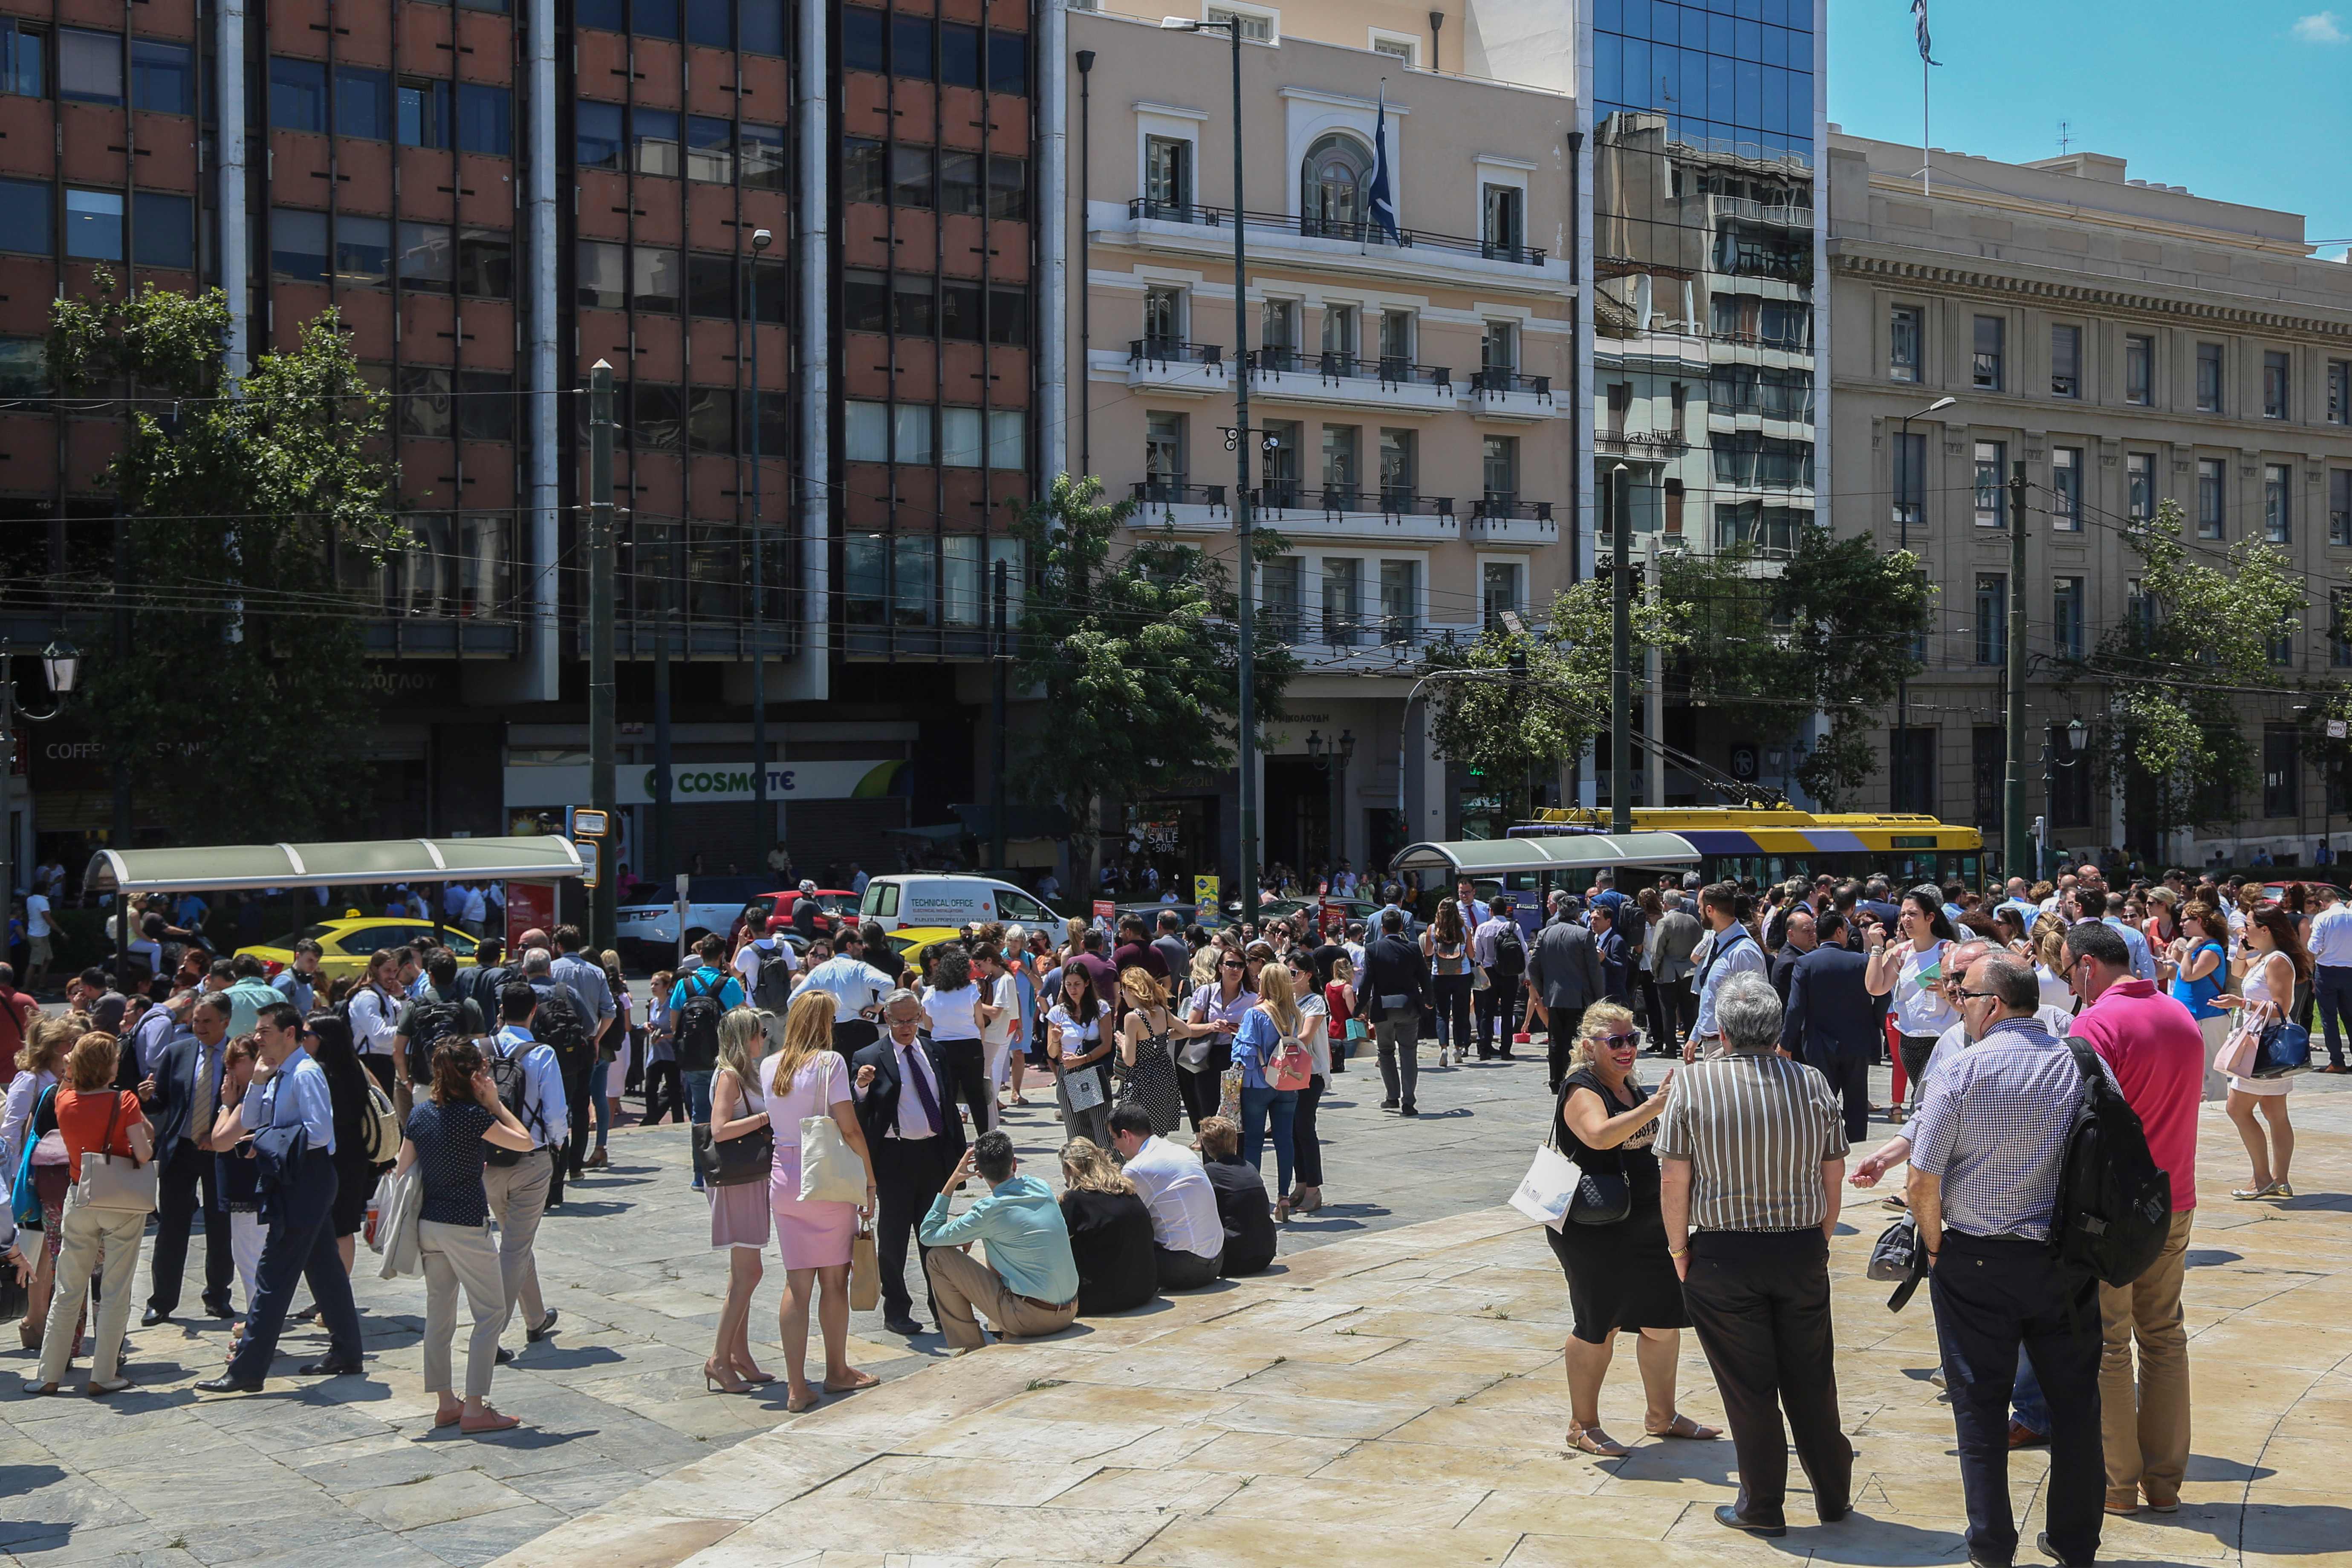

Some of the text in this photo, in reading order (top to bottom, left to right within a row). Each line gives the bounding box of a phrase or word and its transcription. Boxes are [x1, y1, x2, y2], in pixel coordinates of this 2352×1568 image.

[1148, 832, 1179, 843] SALE
[1153, 843, 1175, 852] -50%
[911, 899, 949, 907] TECHNICAL
